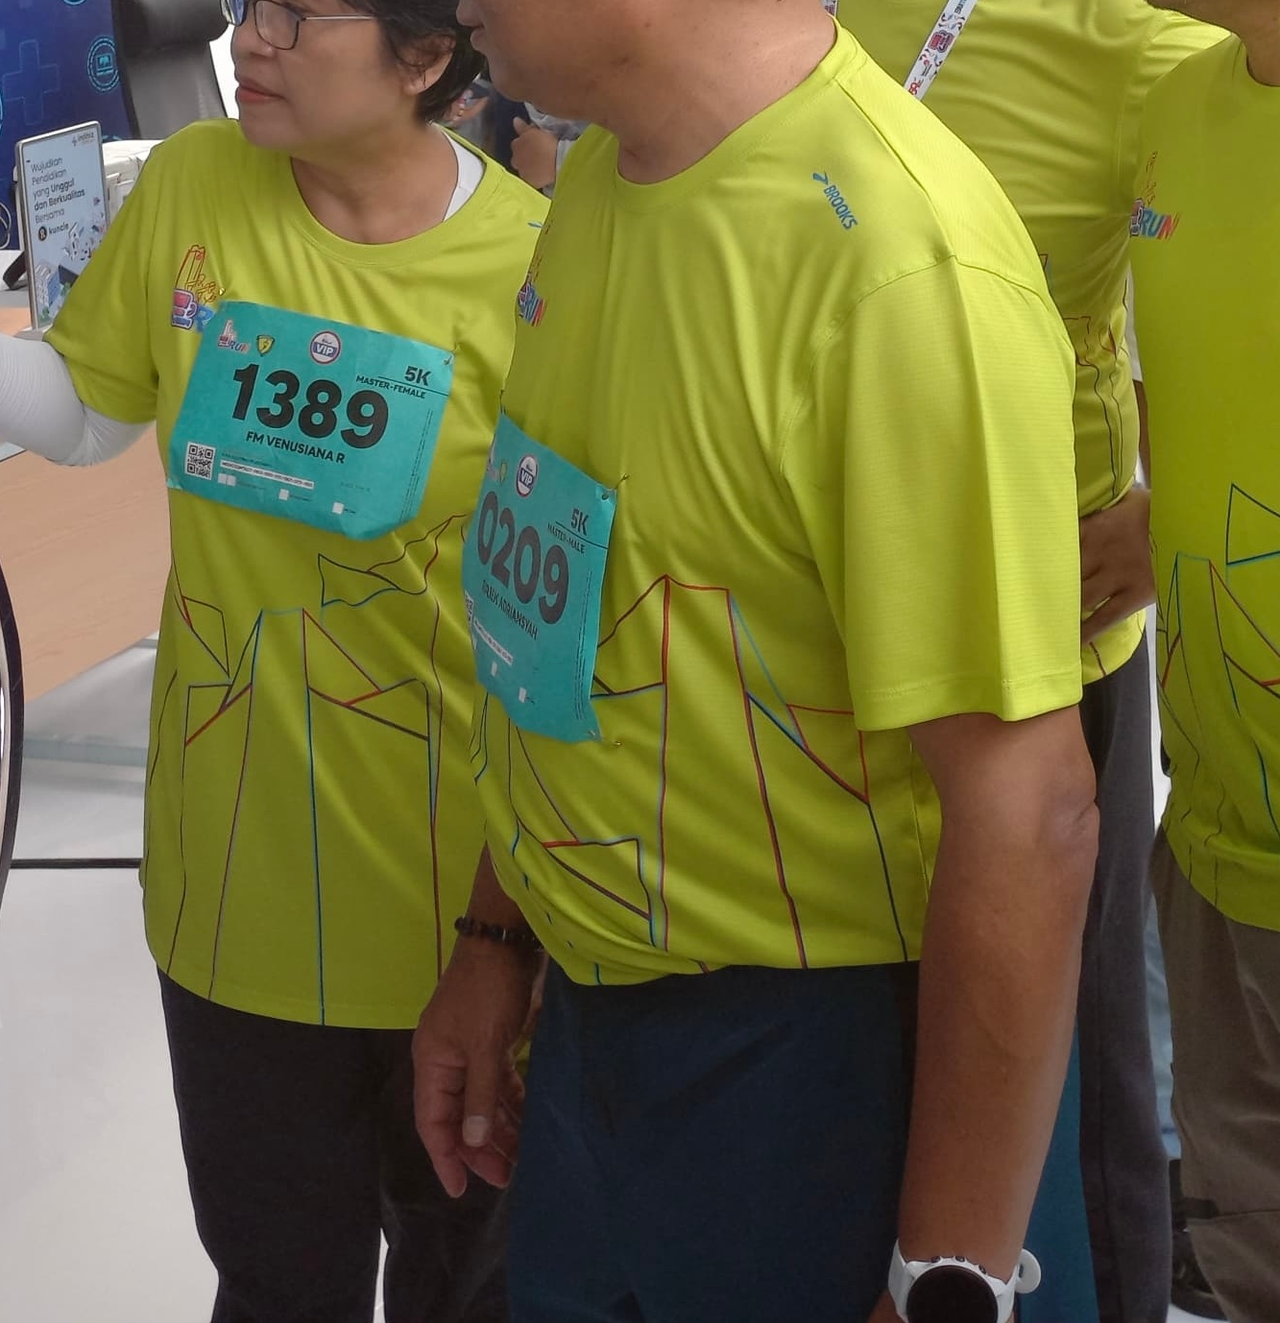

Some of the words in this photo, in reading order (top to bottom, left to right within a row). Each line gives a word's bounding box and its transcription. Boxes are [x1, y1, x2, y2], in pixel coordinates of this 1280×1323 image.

[33, 187, 50, 202] yang
[33, 200, 48, 211] dan
[48, 188, 86, 207] Berkualitas
[823, 184, 859, 230] BROOKS
[316, 343, 334, 356] VIP
[355, 374, 427, 400] MASTER-FEMALE
[404, 365, 433, 387] 5K
[231, 363, 389, 449] 1389
[245, 430, 264, 445] FM
[266, 436, 334, 462] VENUSIANA
[335, 452, 346, 465] R
[521, 469, 533, 487] VIP
[571, 508, 589, 536] 5K
[477, 490, 570, 625] 0209
